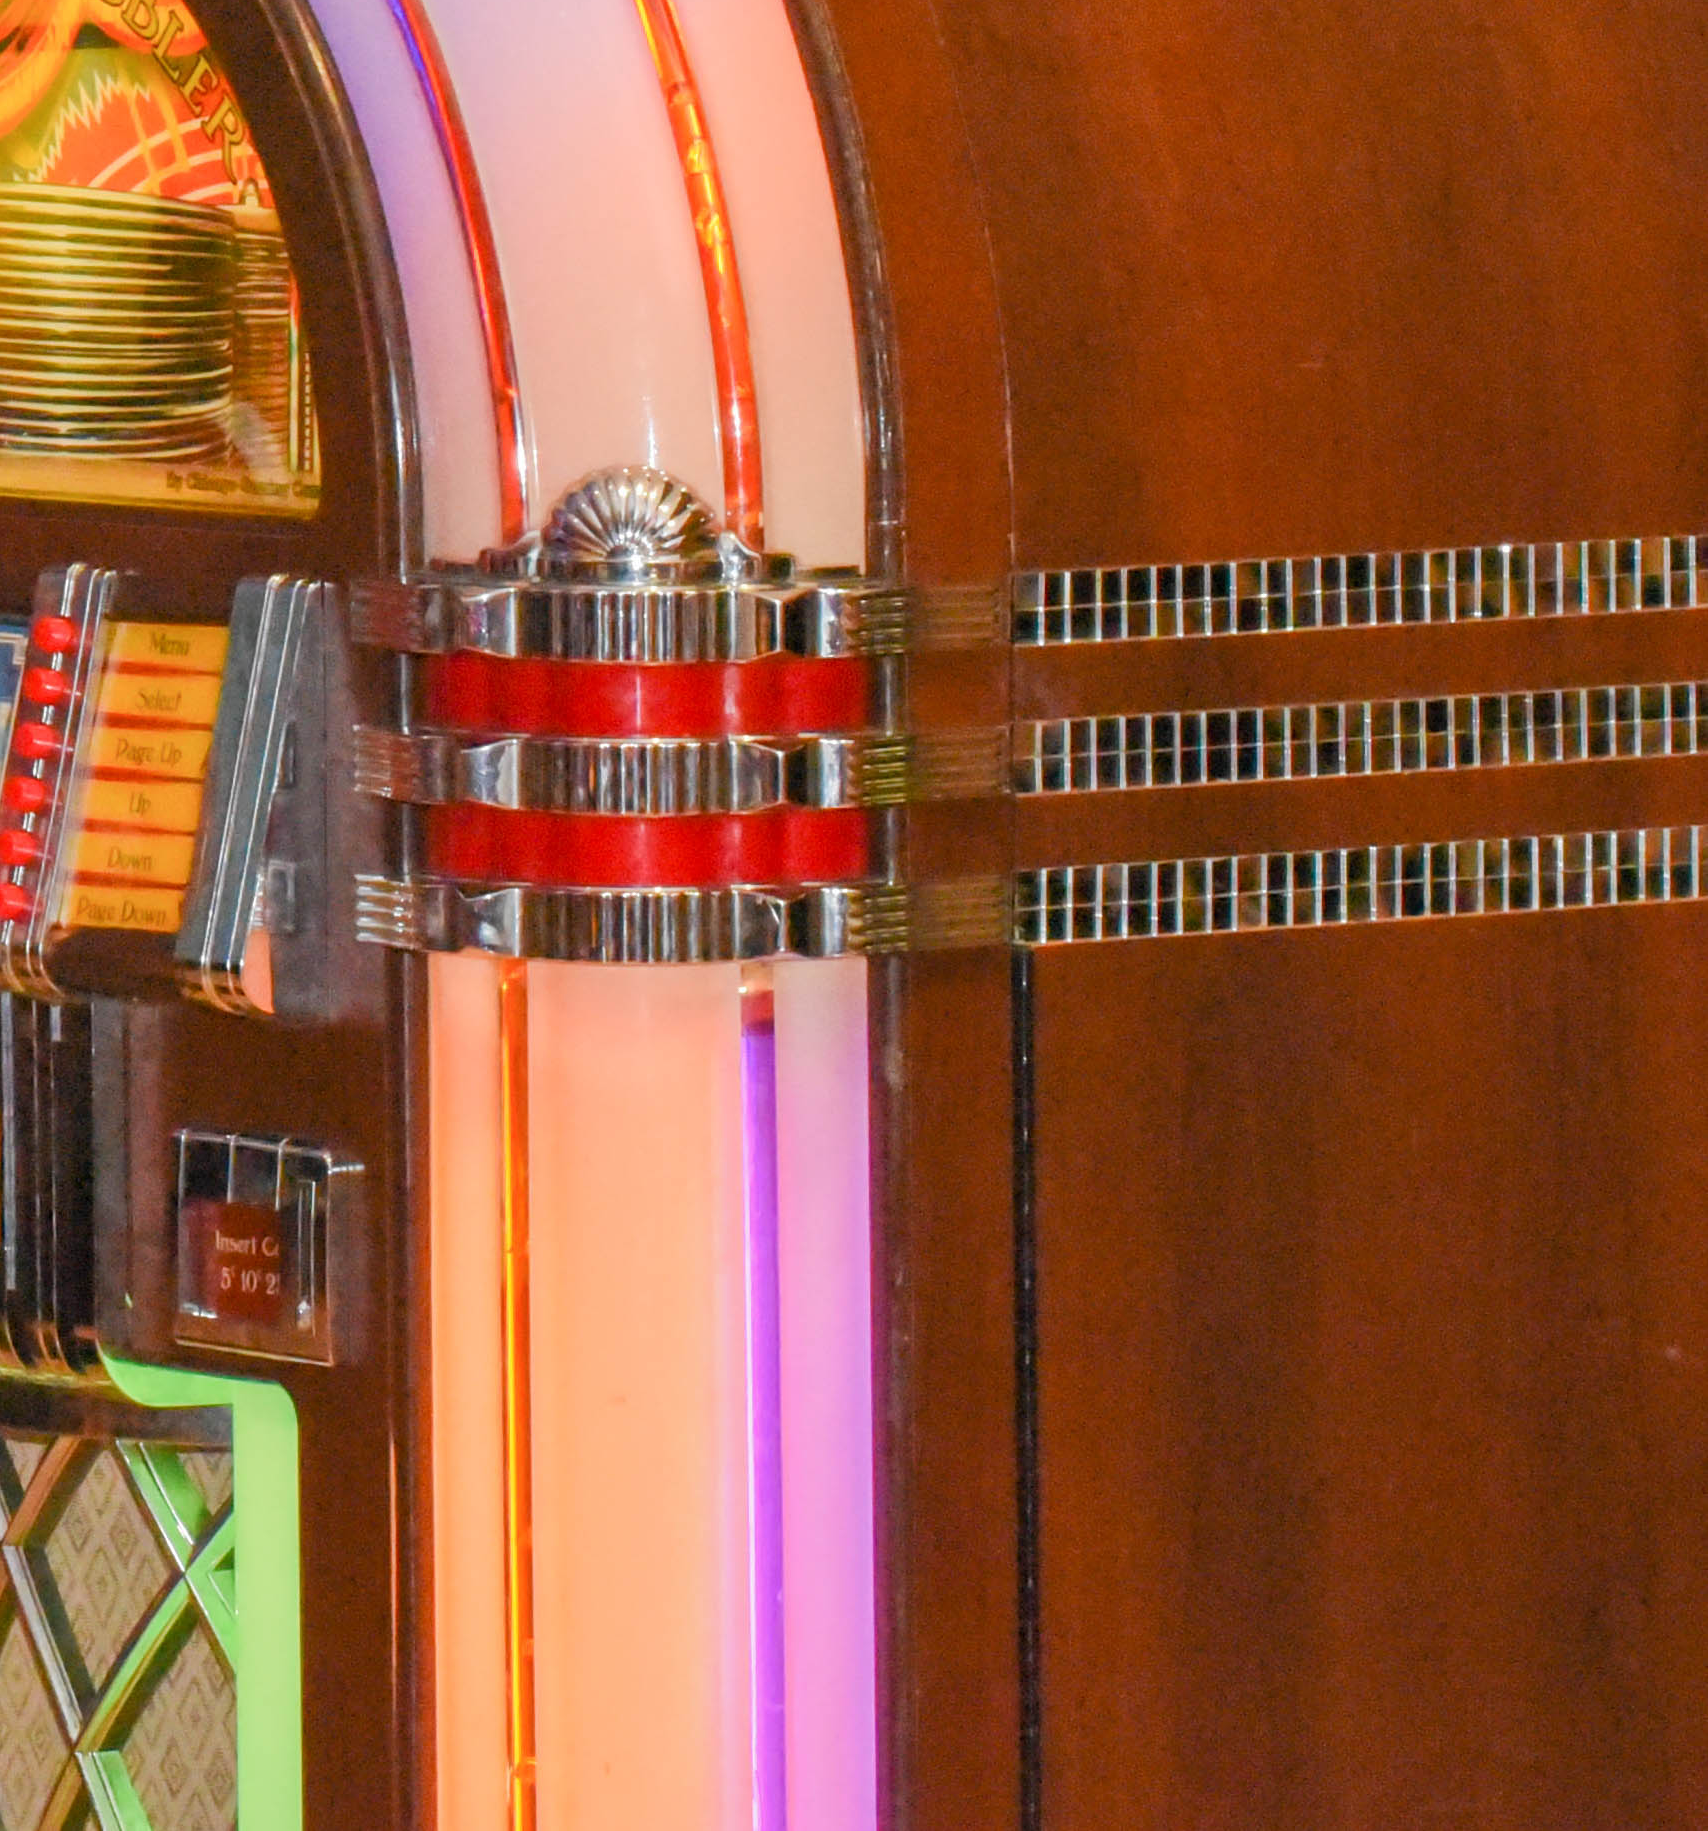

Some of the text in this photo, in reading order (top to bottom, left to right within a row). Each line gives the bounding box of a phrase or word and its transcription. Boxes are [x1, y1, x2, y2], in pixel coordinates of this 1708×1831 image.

[150, 631, 191, 656] Menu
[135, 687, 182, 711] Select
[115, 737, 182, 766] Page Up
[129, 791, 151, 815] Up
[107, 846, 152, 870] Down
[120, 900, 167, 925] Down
[215, 1229, 257, 1255] Insert
